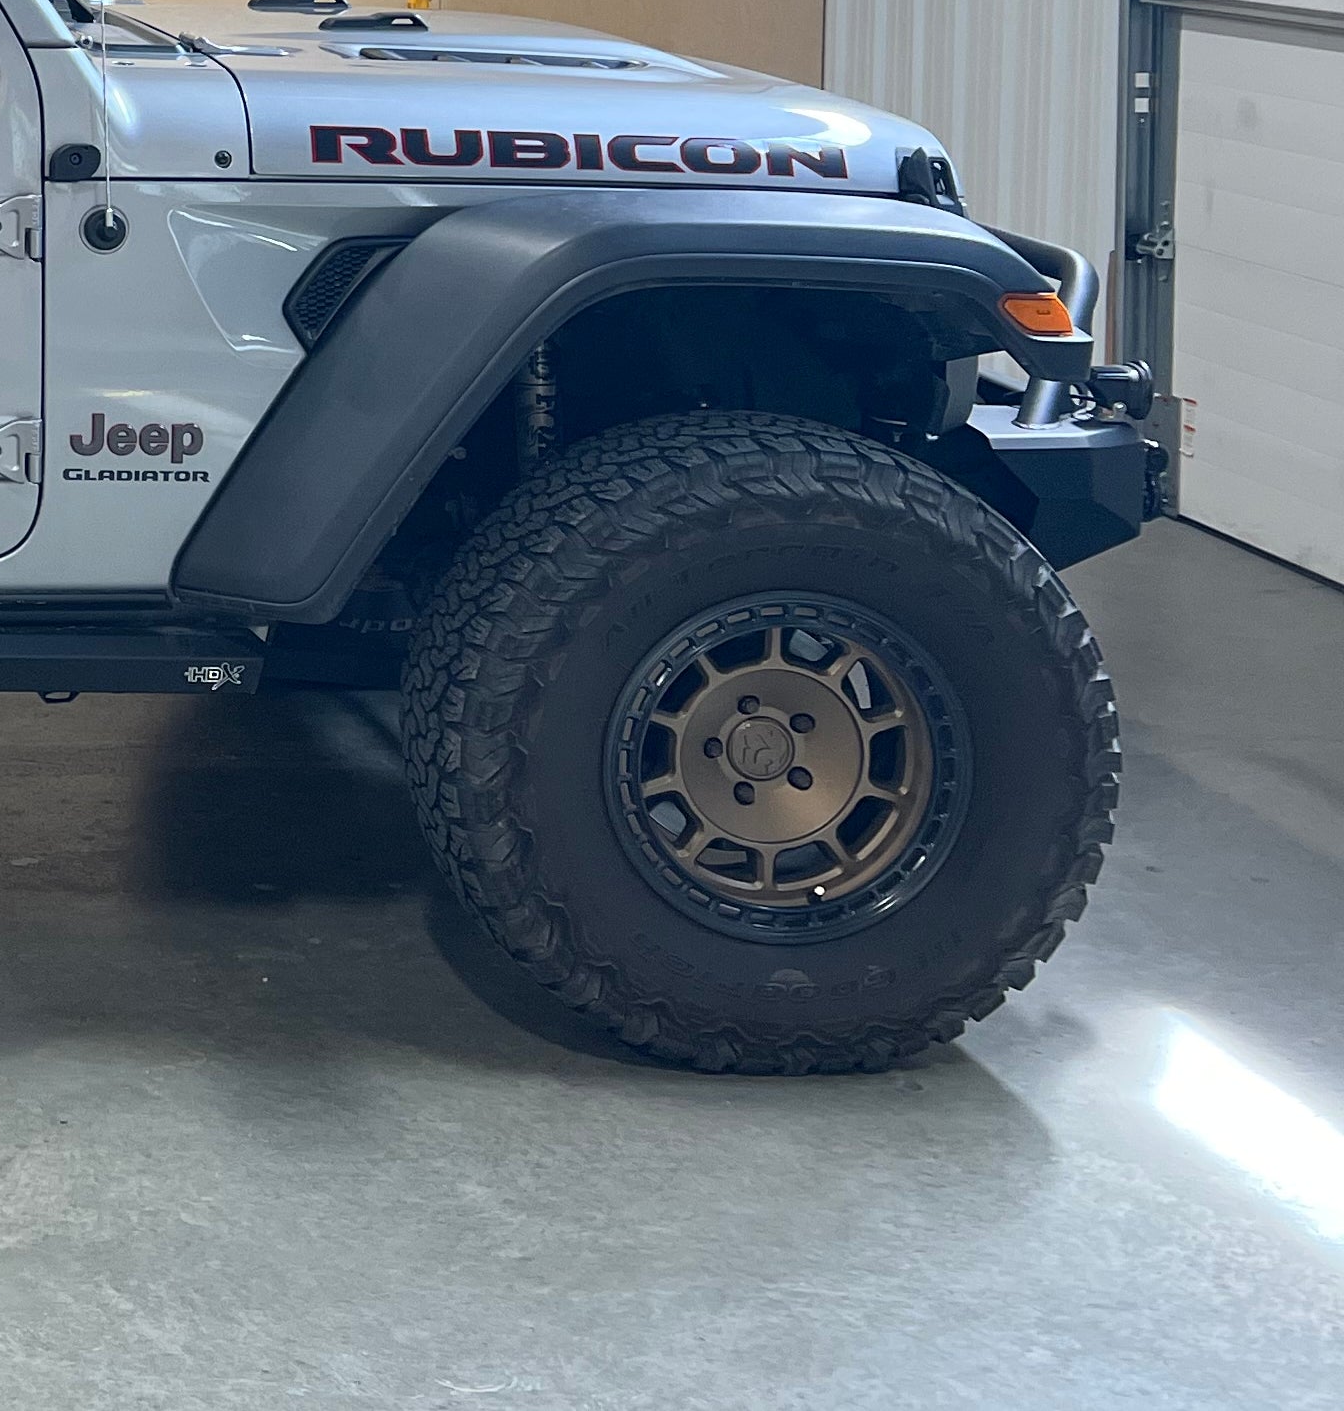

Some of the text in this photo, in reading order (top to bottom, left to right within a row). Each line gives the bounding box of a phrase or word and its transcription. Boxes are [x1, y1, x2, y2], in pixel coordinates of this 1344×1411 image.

[310, 125, 849, 180] RUBICON
[69, 413, 204, 464] Jeep
[62, 468, 211, 483] GLADIATOR
[183, 662, 245, 691] HDX
